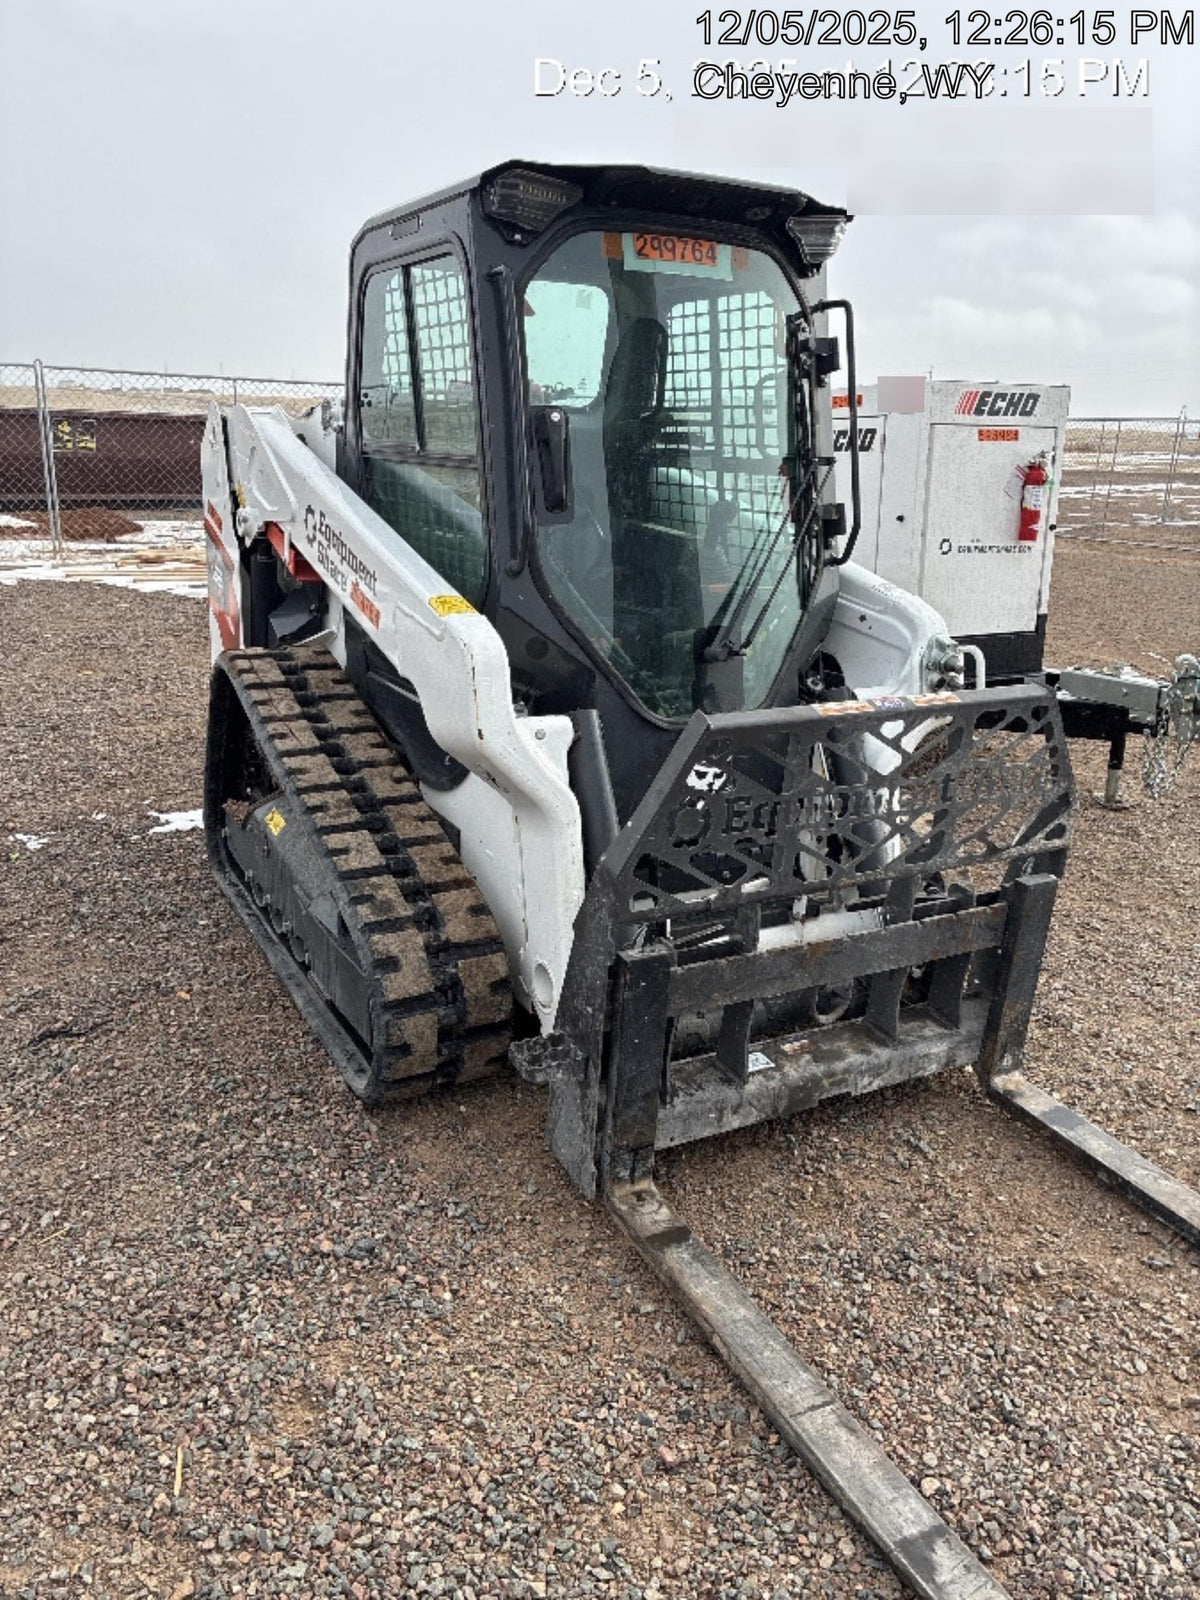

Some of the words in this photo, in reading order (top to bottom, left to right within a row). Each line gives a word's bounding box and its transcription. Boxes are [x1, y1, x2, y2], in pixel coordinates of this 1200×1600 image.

[635, 232, 718, 264] 299764
[973, 391, 1041, 416] ECHO
[833, 428, 877, 452] CHO
[317, 540, 349, 593] Share
[318, 510, 378, 597] Equipment
